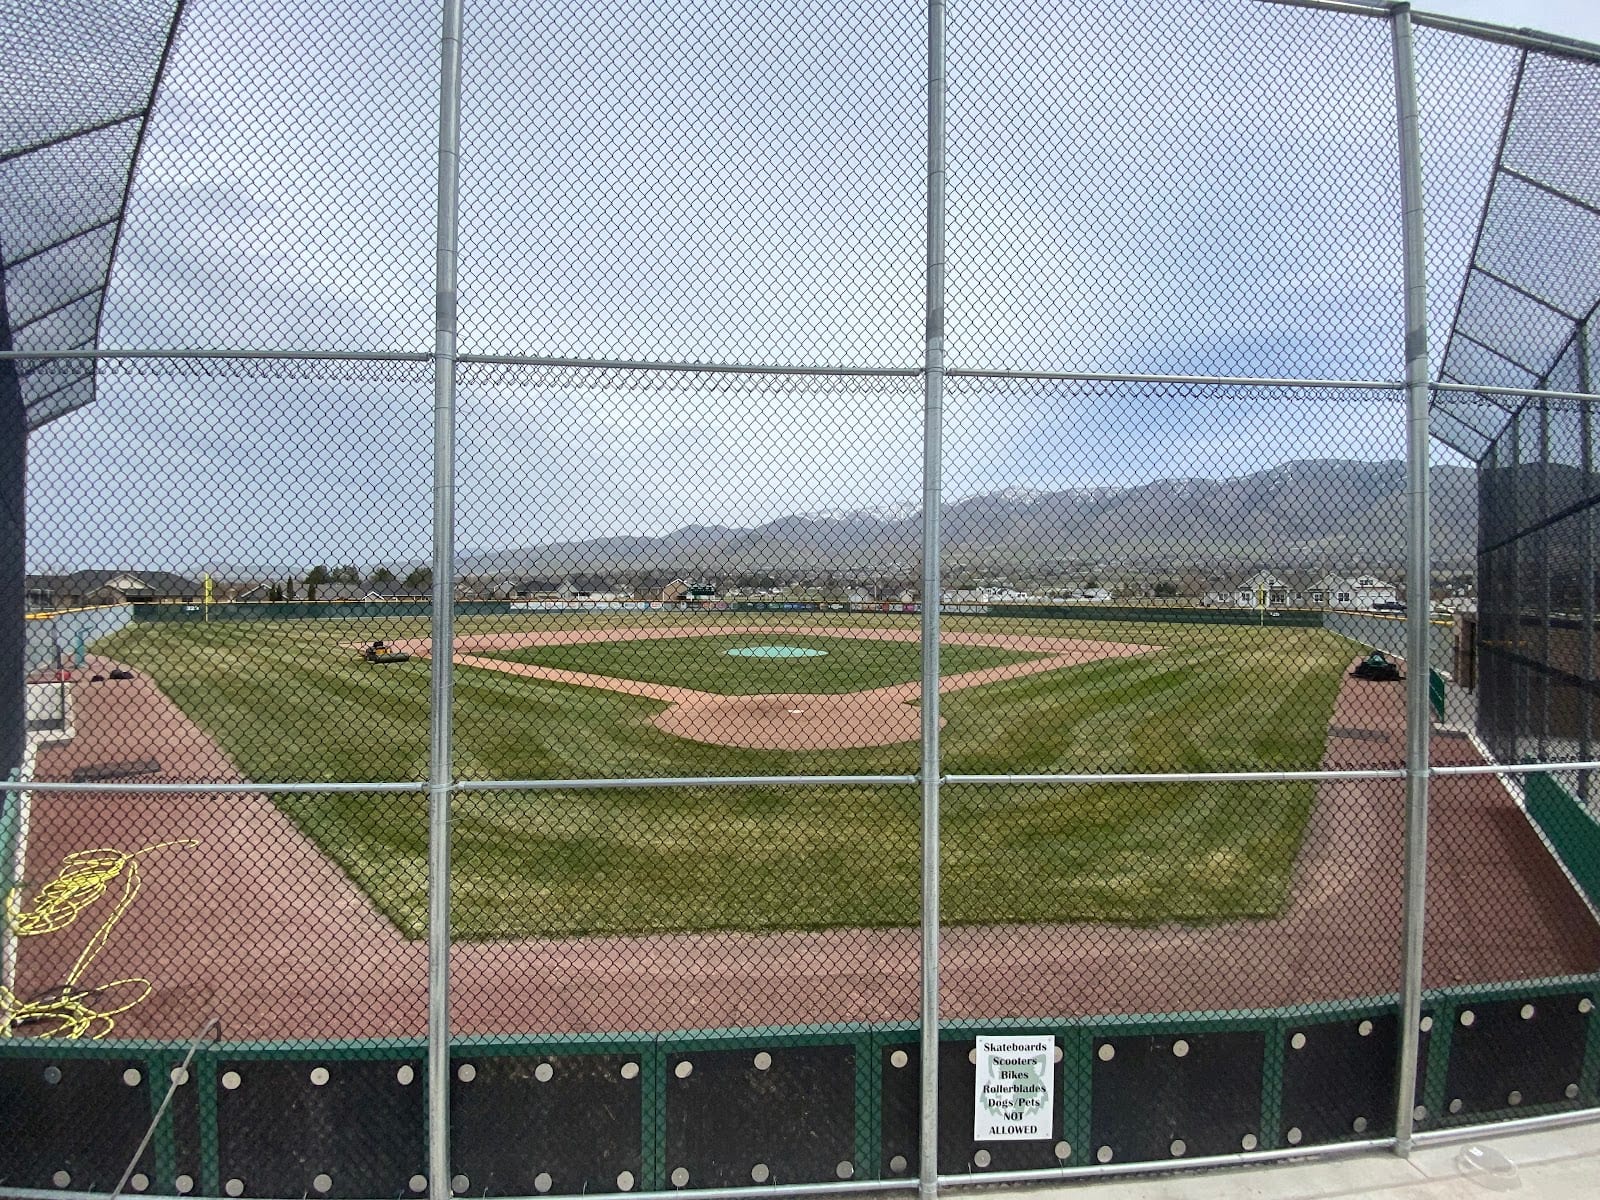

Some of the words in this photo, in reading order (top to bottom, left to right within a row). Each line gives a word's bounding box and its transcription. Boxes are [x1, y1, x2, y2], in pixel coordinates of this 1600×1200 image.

[983, 1042, 1047, 1052] Skateboards
[992, 1056, 1038, 1066] Scooters
[1001, 1070, 1029, 1080] Bikes
[982, 1084, 1047, 1094] Rollerblades
[988, 1098, 1041, 1109] Dogs/Pets
[1003, 1111, 1025, 1121] NOT
[989, 1125, 1038, 1135] ALLOWED
